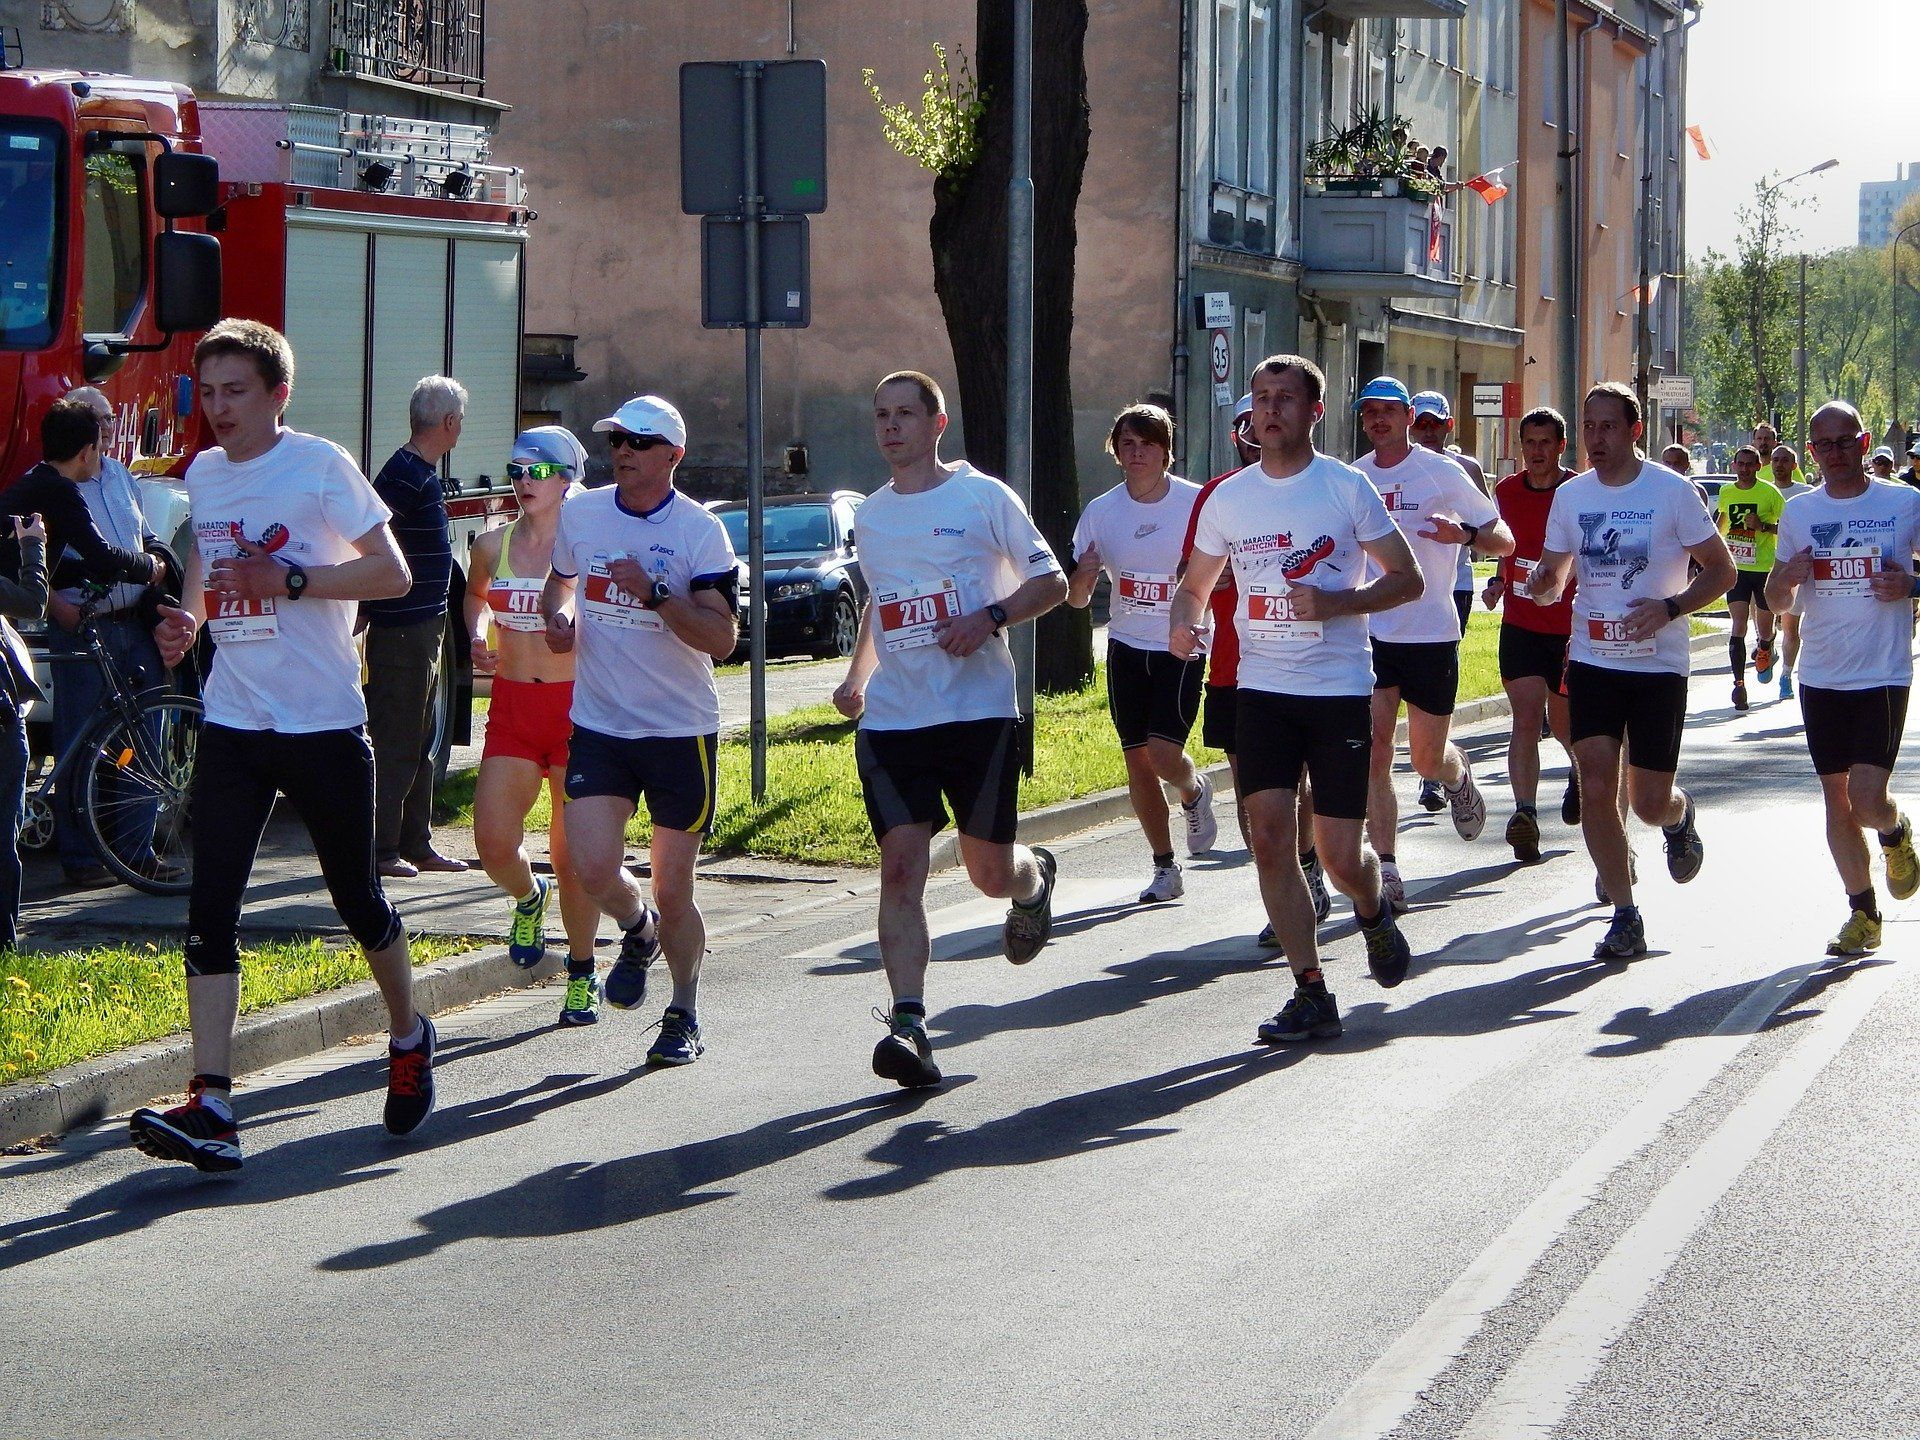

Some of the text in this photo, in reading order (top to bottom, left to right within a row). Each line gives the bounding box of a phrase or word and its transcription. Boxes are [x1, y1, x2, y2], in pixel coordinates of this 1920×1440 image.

[1242, 534, 1278, 545] MARATON
[1829, 559, 1866, 579] 306
[1133, 582, 1160, 600] 376
[508, 591, 539, 612] 477
[899, 597, 938, 626] 270
